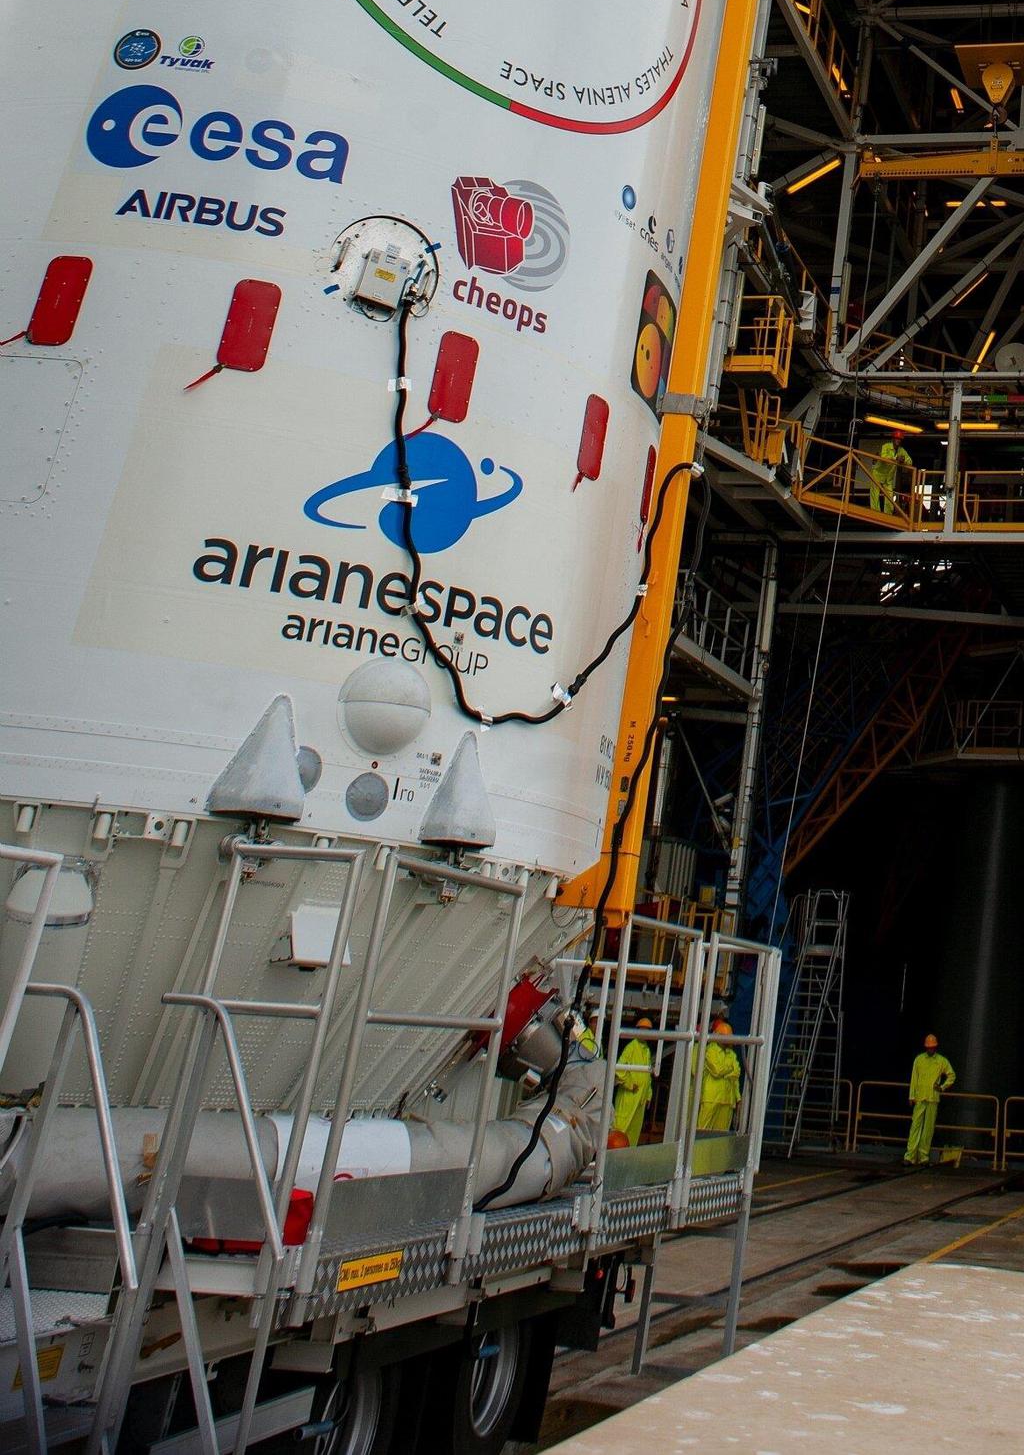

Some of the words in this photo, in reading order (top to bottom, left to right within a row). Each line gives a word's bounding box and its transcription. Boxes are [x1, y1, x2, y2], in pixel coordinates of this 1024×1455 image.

[160, 55, 215, 69] Tyvak
[499, 60, 566, 101] SPACE
[635, 46, 674, 95] THALES
[573, 82, 631, 105] ALENIA
[189, 111, 350, 184] esa
[115, 188, 287, 237] AIRBUS
[640, 227, 659, 253] cnes
[452, 276, 548, 333] cheops
[192, 536, 553, 654] arianespace
[627, 734, 635, 751] 250
